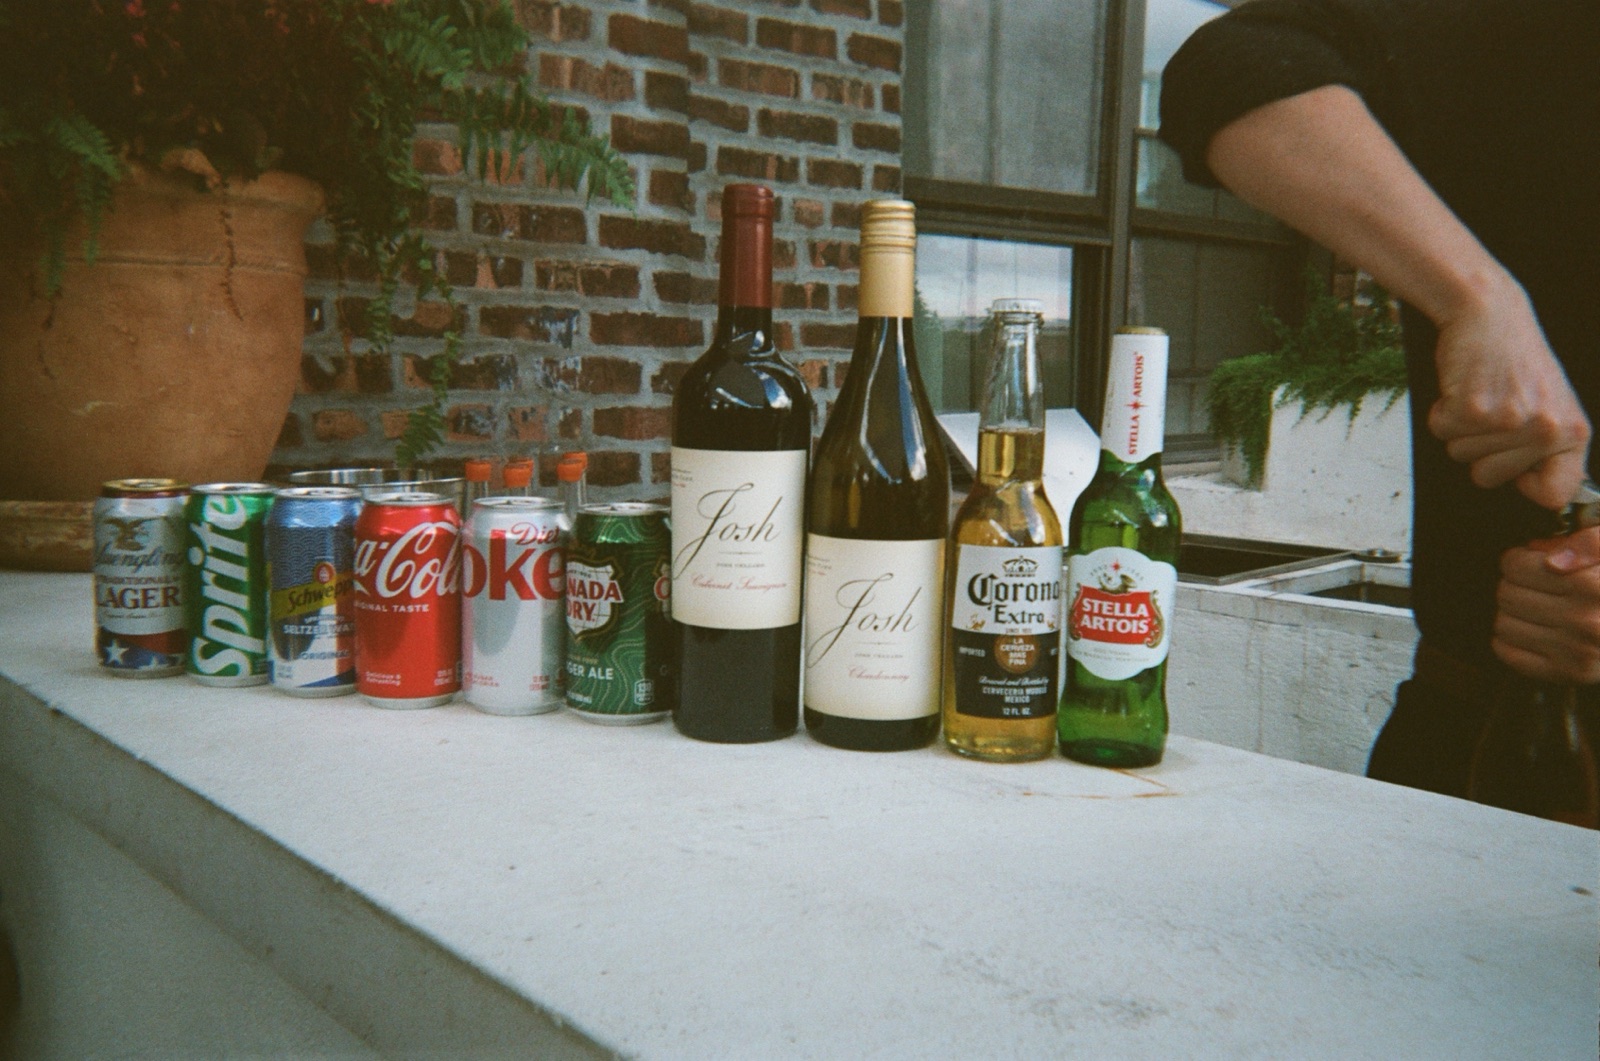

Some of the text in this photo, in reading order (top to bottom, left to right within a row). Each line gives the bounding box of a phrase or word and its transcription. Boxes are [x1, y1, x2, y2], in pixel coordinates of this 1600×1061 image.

[1129, 353, 1144, 455] STELLA ARTOIS
[510, 521, 560, 546] Diet
[672, 481, 783, 580] Josh
[96, 585, 180, 609] LAGER
[188, 494, 265, 677] Sprite
[967, 572, 1060, 610] Corona
[392, 603, 430, 613] TASTE
[993, 604, 1045, 624] Extra
[1082, 598, 1149, 617] STELLA
[805, 572, 922, 669] Josh
[1080, 614, 1150, 634] ARTOIS
[587, 666, 615, 681] ALE
